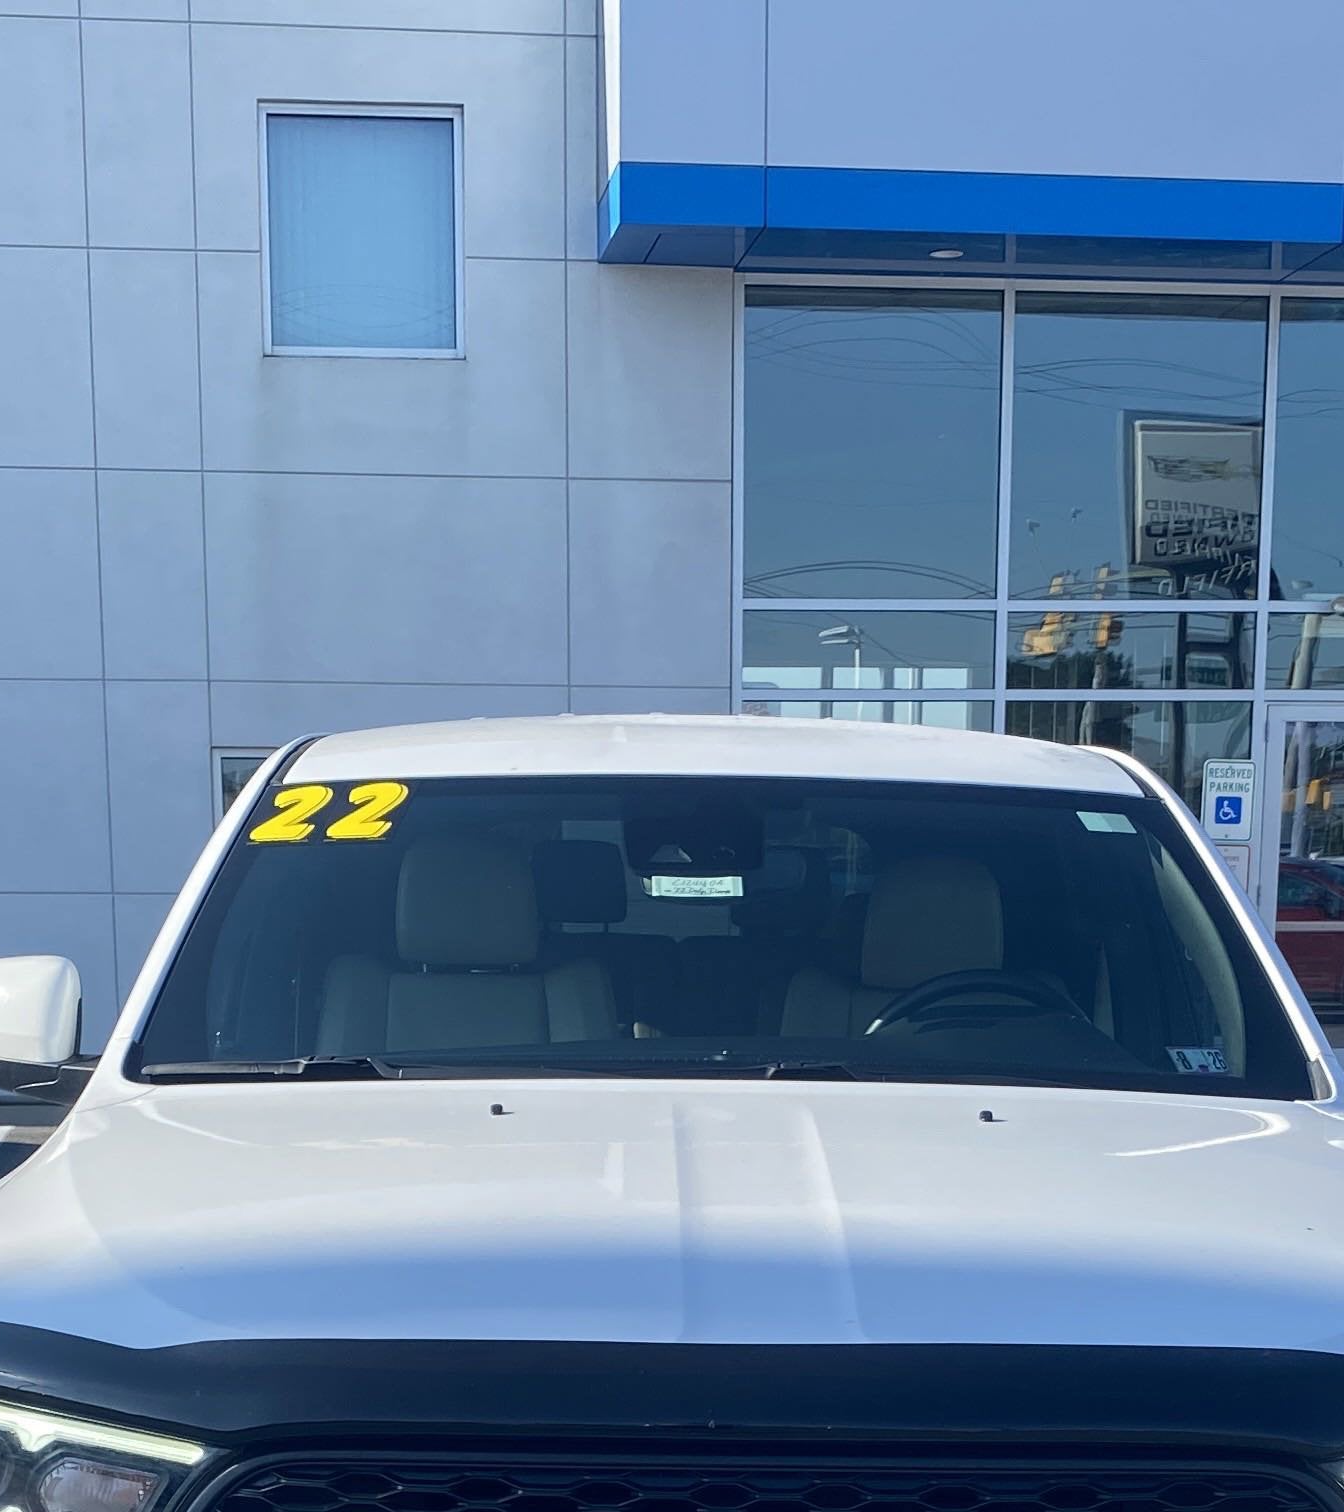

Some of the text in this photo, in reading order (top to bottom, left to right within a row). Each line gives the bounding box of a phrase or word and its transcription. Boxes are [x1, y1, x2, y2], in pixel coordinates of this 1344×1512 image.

[1208, 767, 1253, 780] RESERVED
[1209, 781, 1250, 793] PARKING
[249, 782, 409, 842] 22
[1175, 1050, 1227, 1070] 8 26
